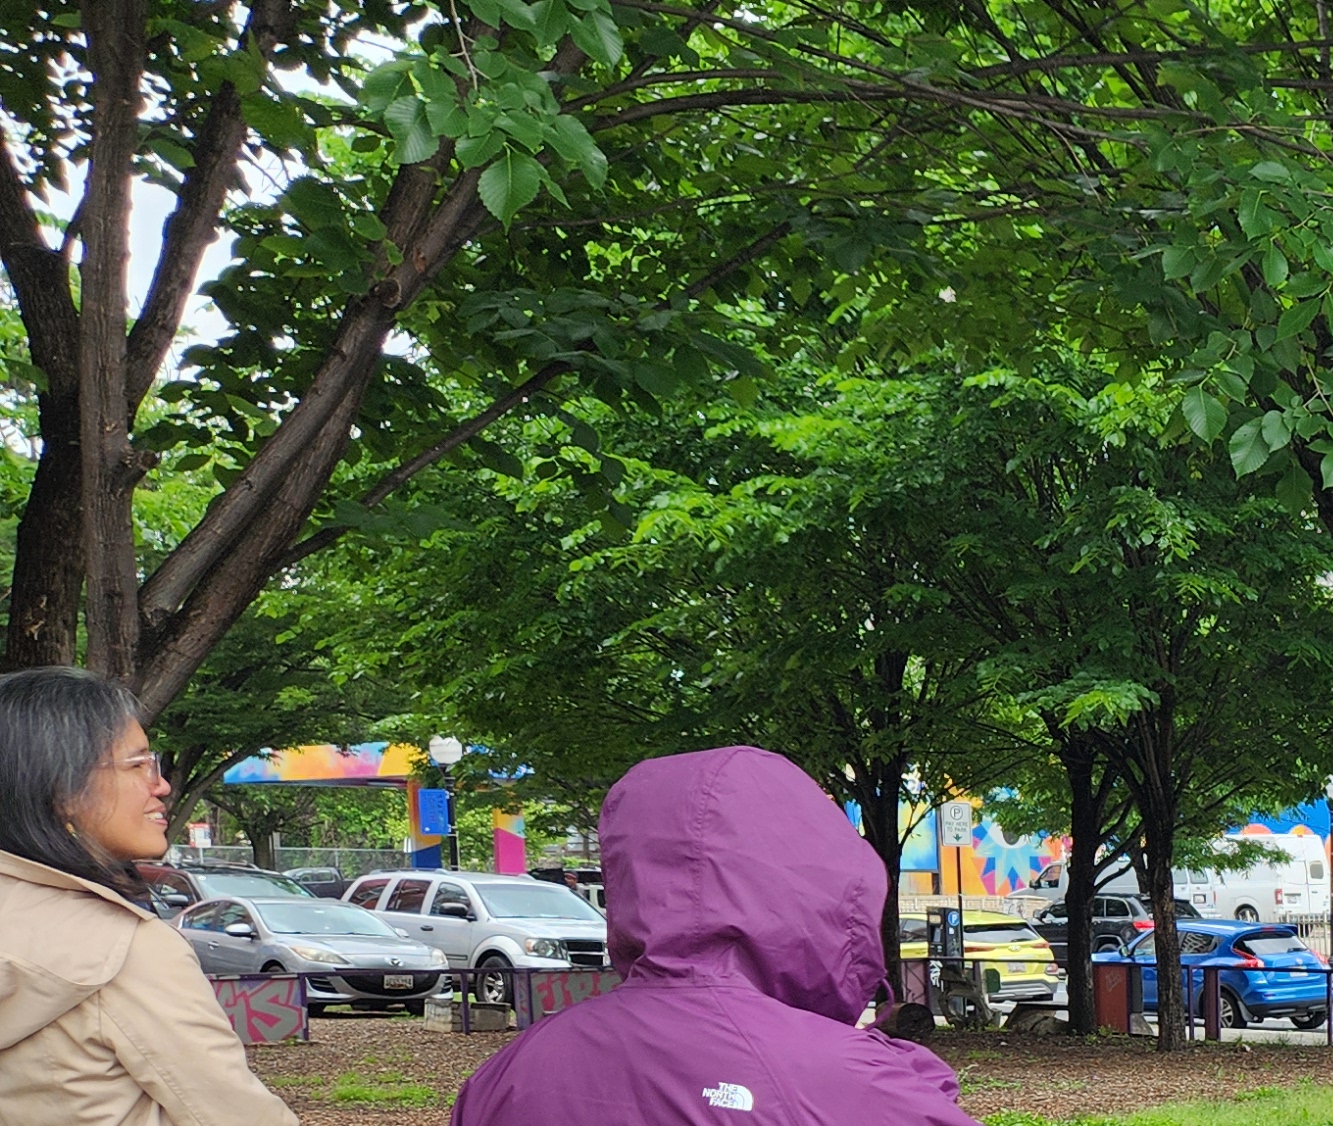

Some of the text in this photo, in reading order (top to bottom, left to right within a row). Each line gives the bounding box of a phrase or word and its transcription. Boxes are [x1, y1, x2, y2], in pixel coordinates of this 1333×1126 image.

[718, 1082, 738, 1092] THE
[702, 1087, 737, 1100] NORTH
[709, 1098, 734, 1109] FACE
